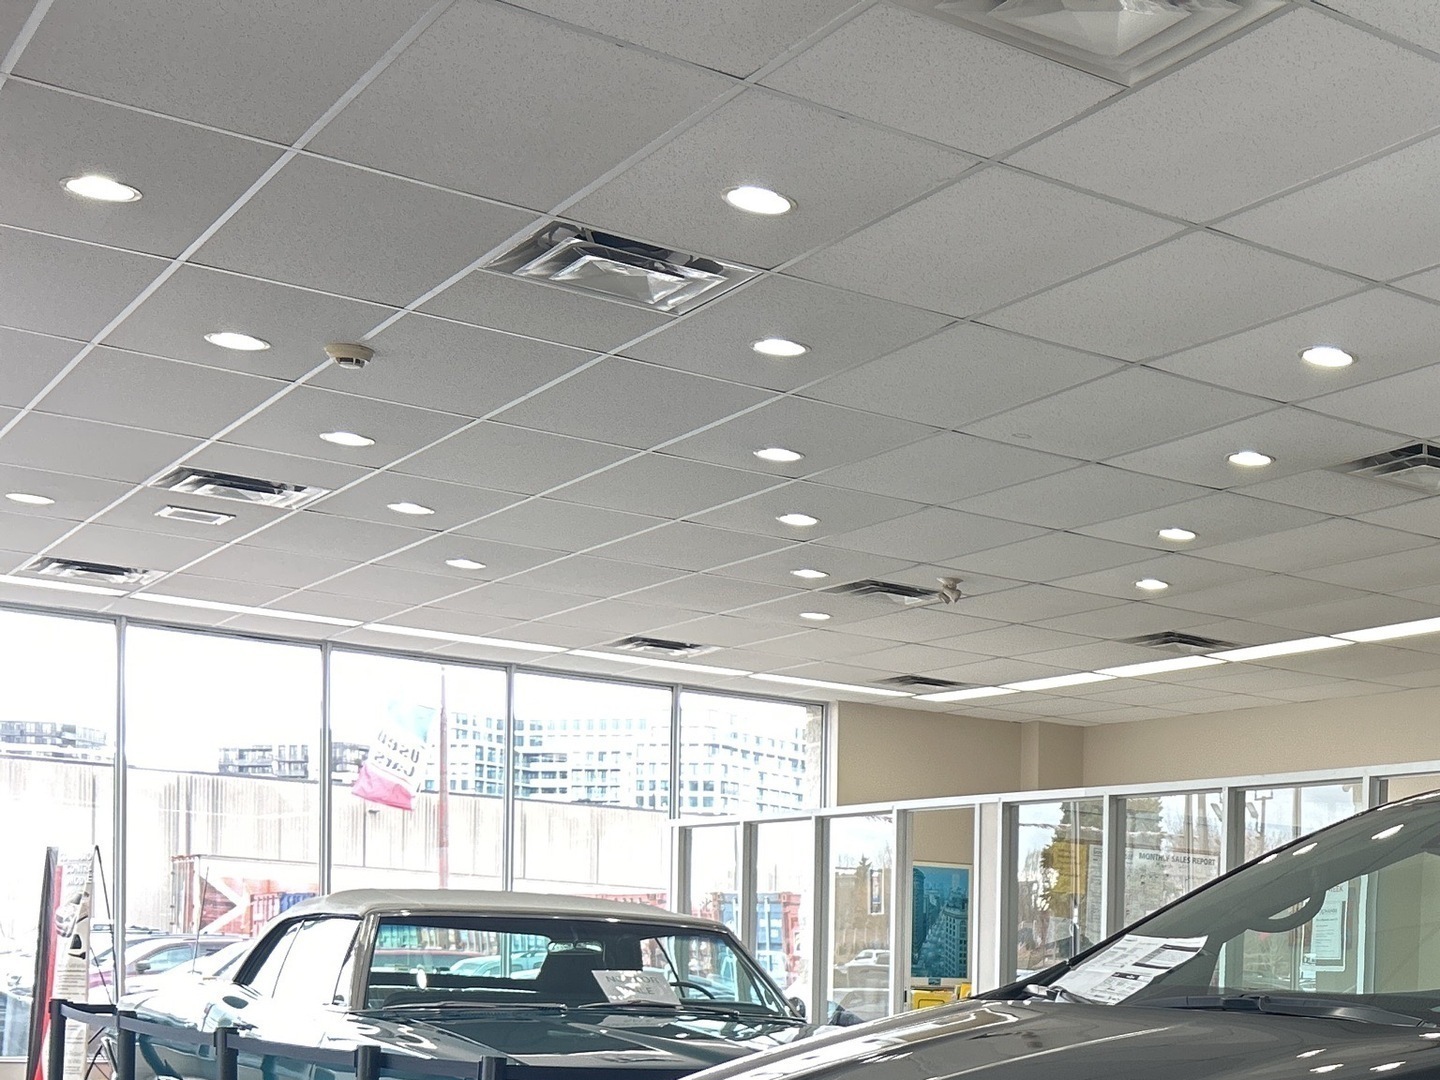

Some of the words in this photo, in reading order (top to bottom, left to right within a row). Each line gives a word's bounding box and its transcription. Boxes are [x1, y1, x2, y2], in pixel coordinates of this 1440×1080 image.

[1138, 852, 1170, 862] MONTHLY
[1171, 854, 1191, 864] SALES
[1192, 857, 1216, 866] REPORT
